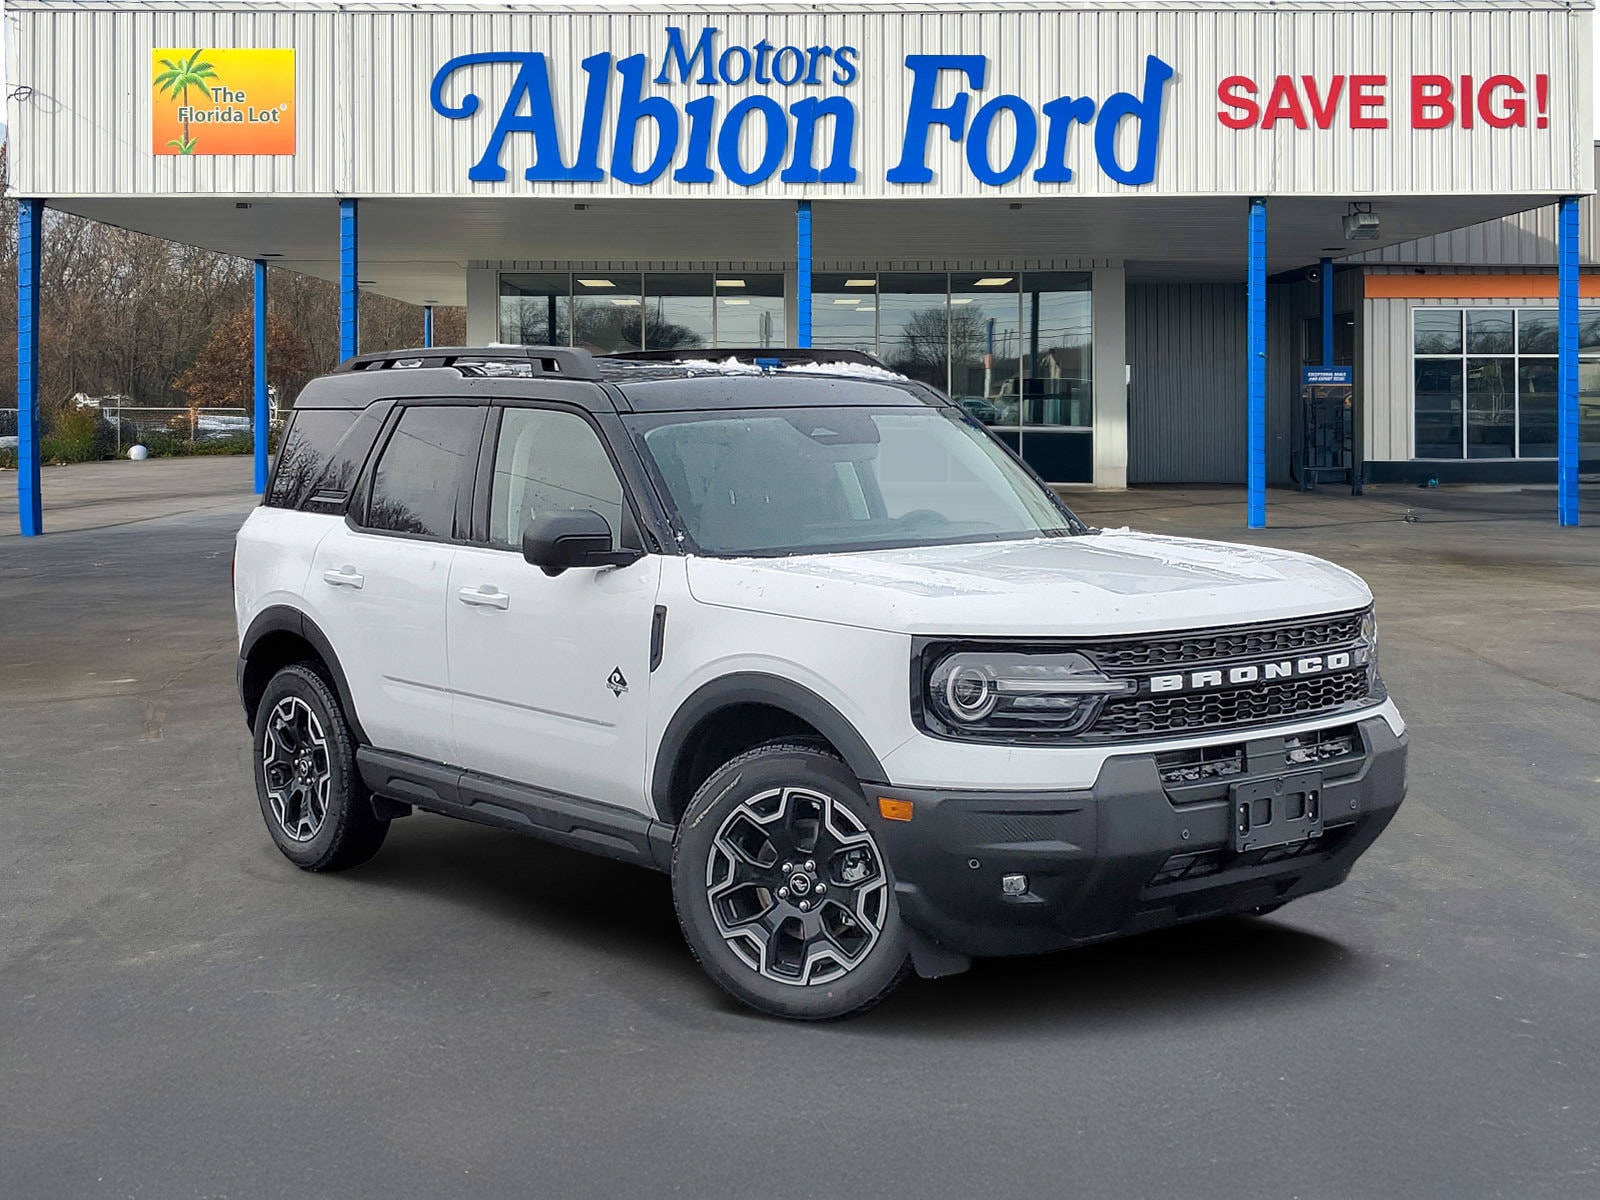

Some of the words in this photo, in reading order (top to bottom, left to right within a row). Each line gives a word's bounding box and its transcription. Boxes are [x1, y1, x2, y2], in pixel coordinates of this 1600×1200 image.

[655, 28, 857, 86] Motors
[178, 106, 244, 122] Florida
[249, 107, 279, 122] Lot
[211, 86, 246, 103] The
[1217, 75, 1388, 129] SAVE
[1411, 74, 1548, 129] BIG!
[429, 52, 857, 186] Albion
[886, 55, 1174, 186] Ford
[1150, 652, 1350, 693] BRONCO
